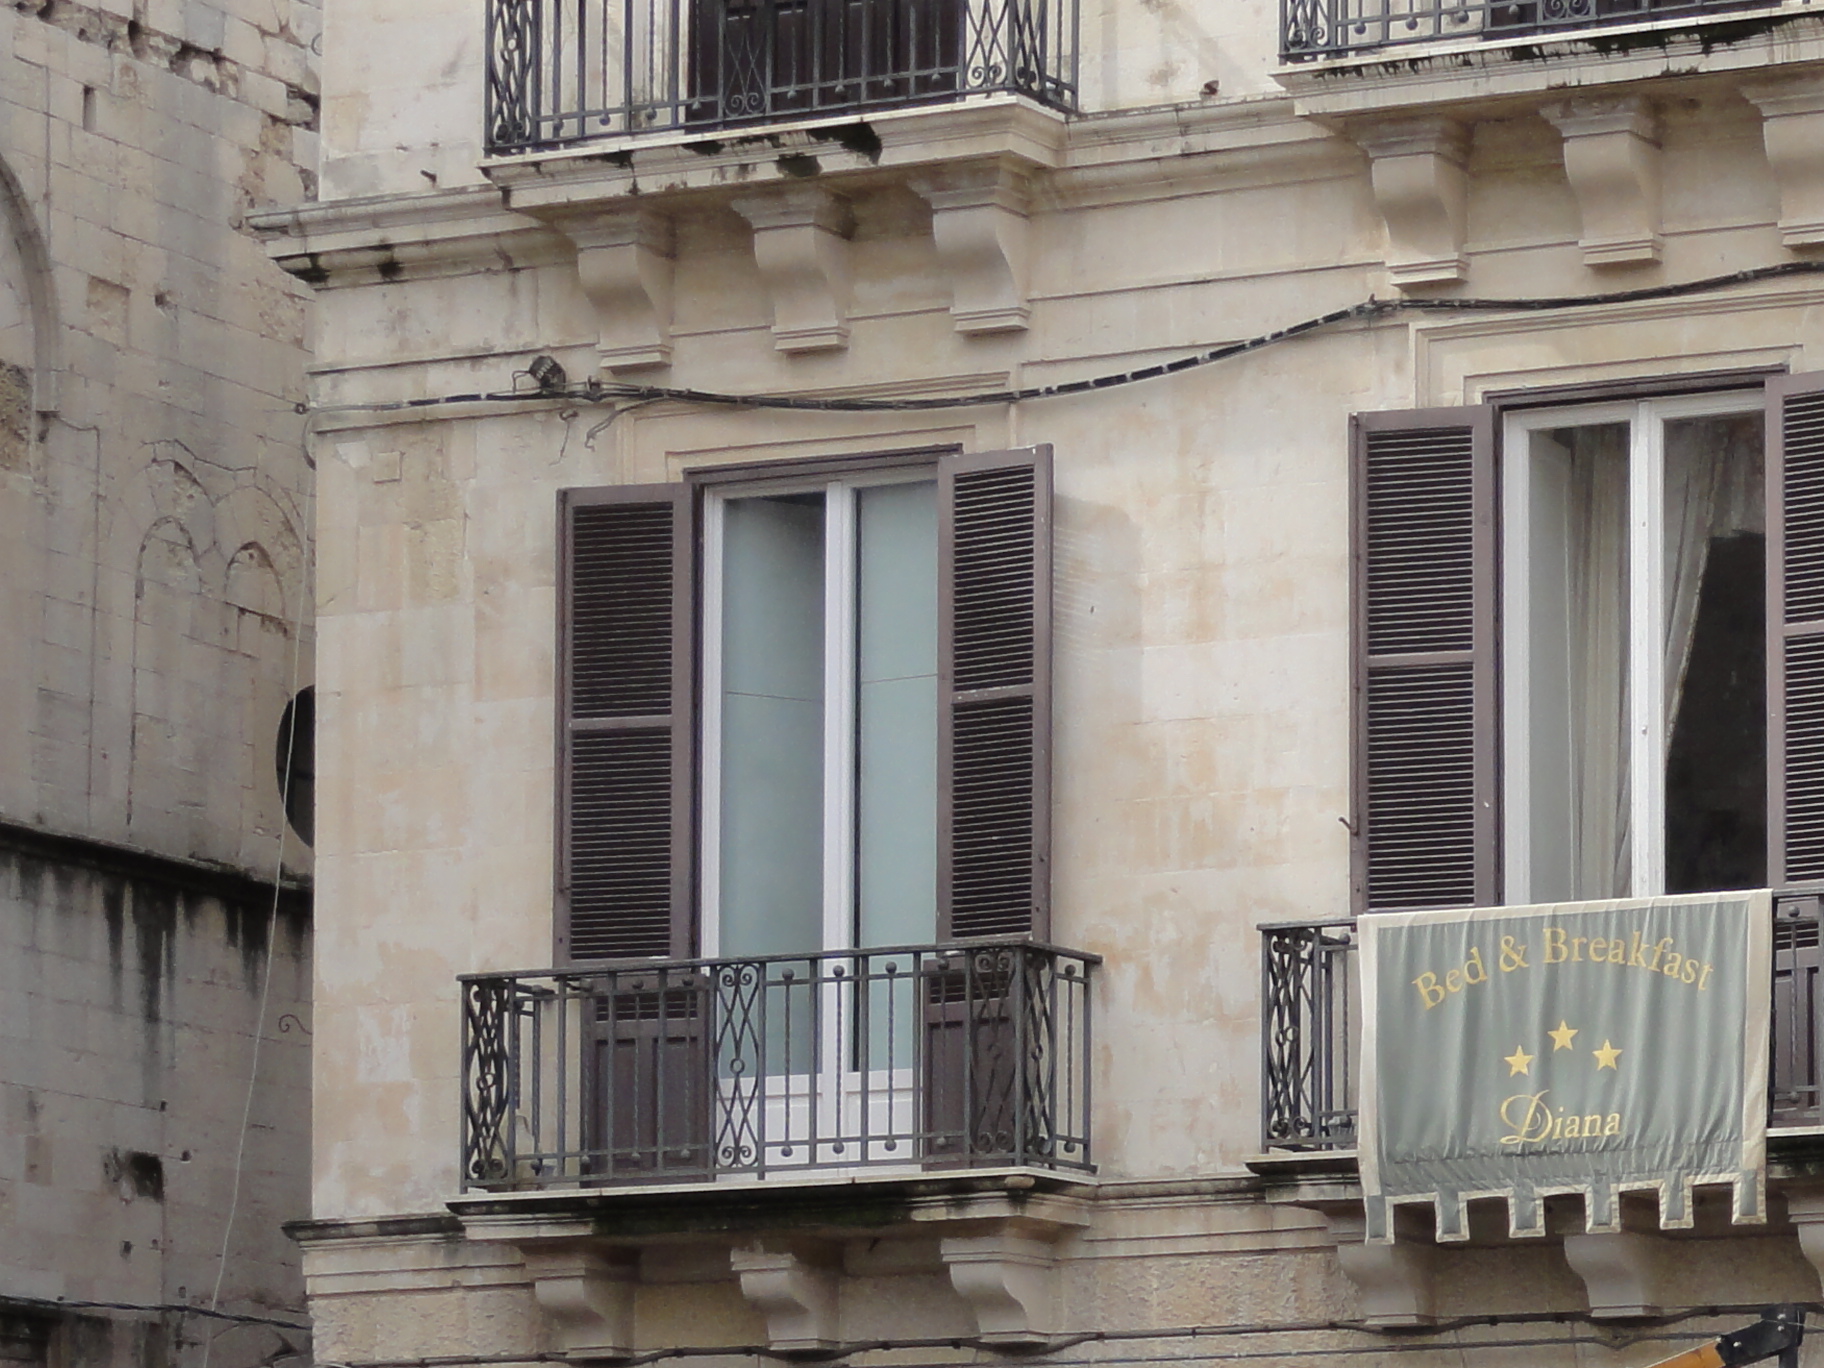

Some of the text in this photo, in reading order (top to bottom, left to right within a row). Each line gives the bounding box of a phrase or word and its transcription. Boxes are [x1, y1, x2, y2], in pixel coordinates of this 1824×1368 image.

[1412, 927, 1714, 1010] Bed & Breakfast
[1500, 1089, 1621, 1144] Diana
